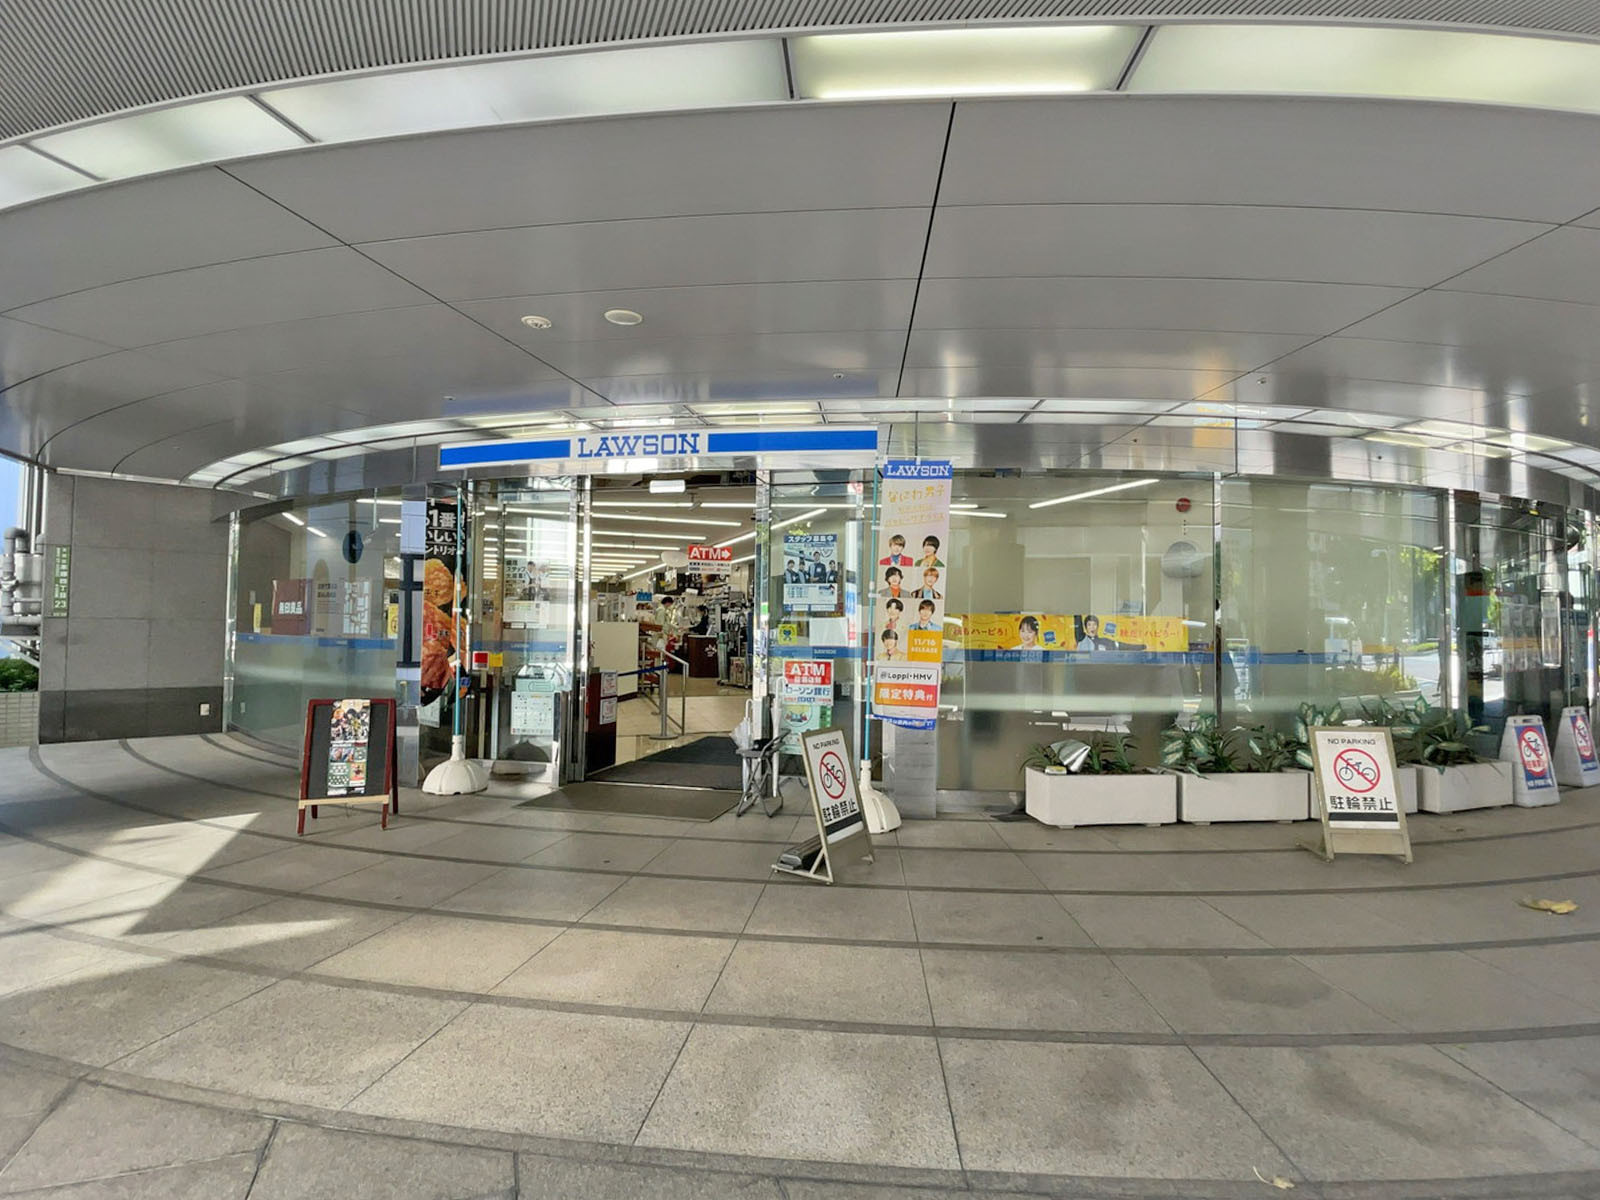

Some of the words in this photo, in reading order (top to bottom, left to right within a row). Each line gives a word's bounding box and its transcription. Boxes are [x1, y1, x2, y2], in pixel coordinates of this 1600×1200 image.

[577, 433, 700, 458] LAWSON
[887, 465, 949, 477] LAWSON
[690, 547, 721, 560] ATM
[54, 600, 67, 608] 23
[913, 638, 937, 646] 11/16
[790, 663, 826, 677] ATM
[785, 686, 831, 697] ローソン銀行
[1341, 738, 1376, 746] PARKING
[1330, 795, 1394, 811] 駐輪禁止
[822, 798, 857, 822] 駐輪禁止
